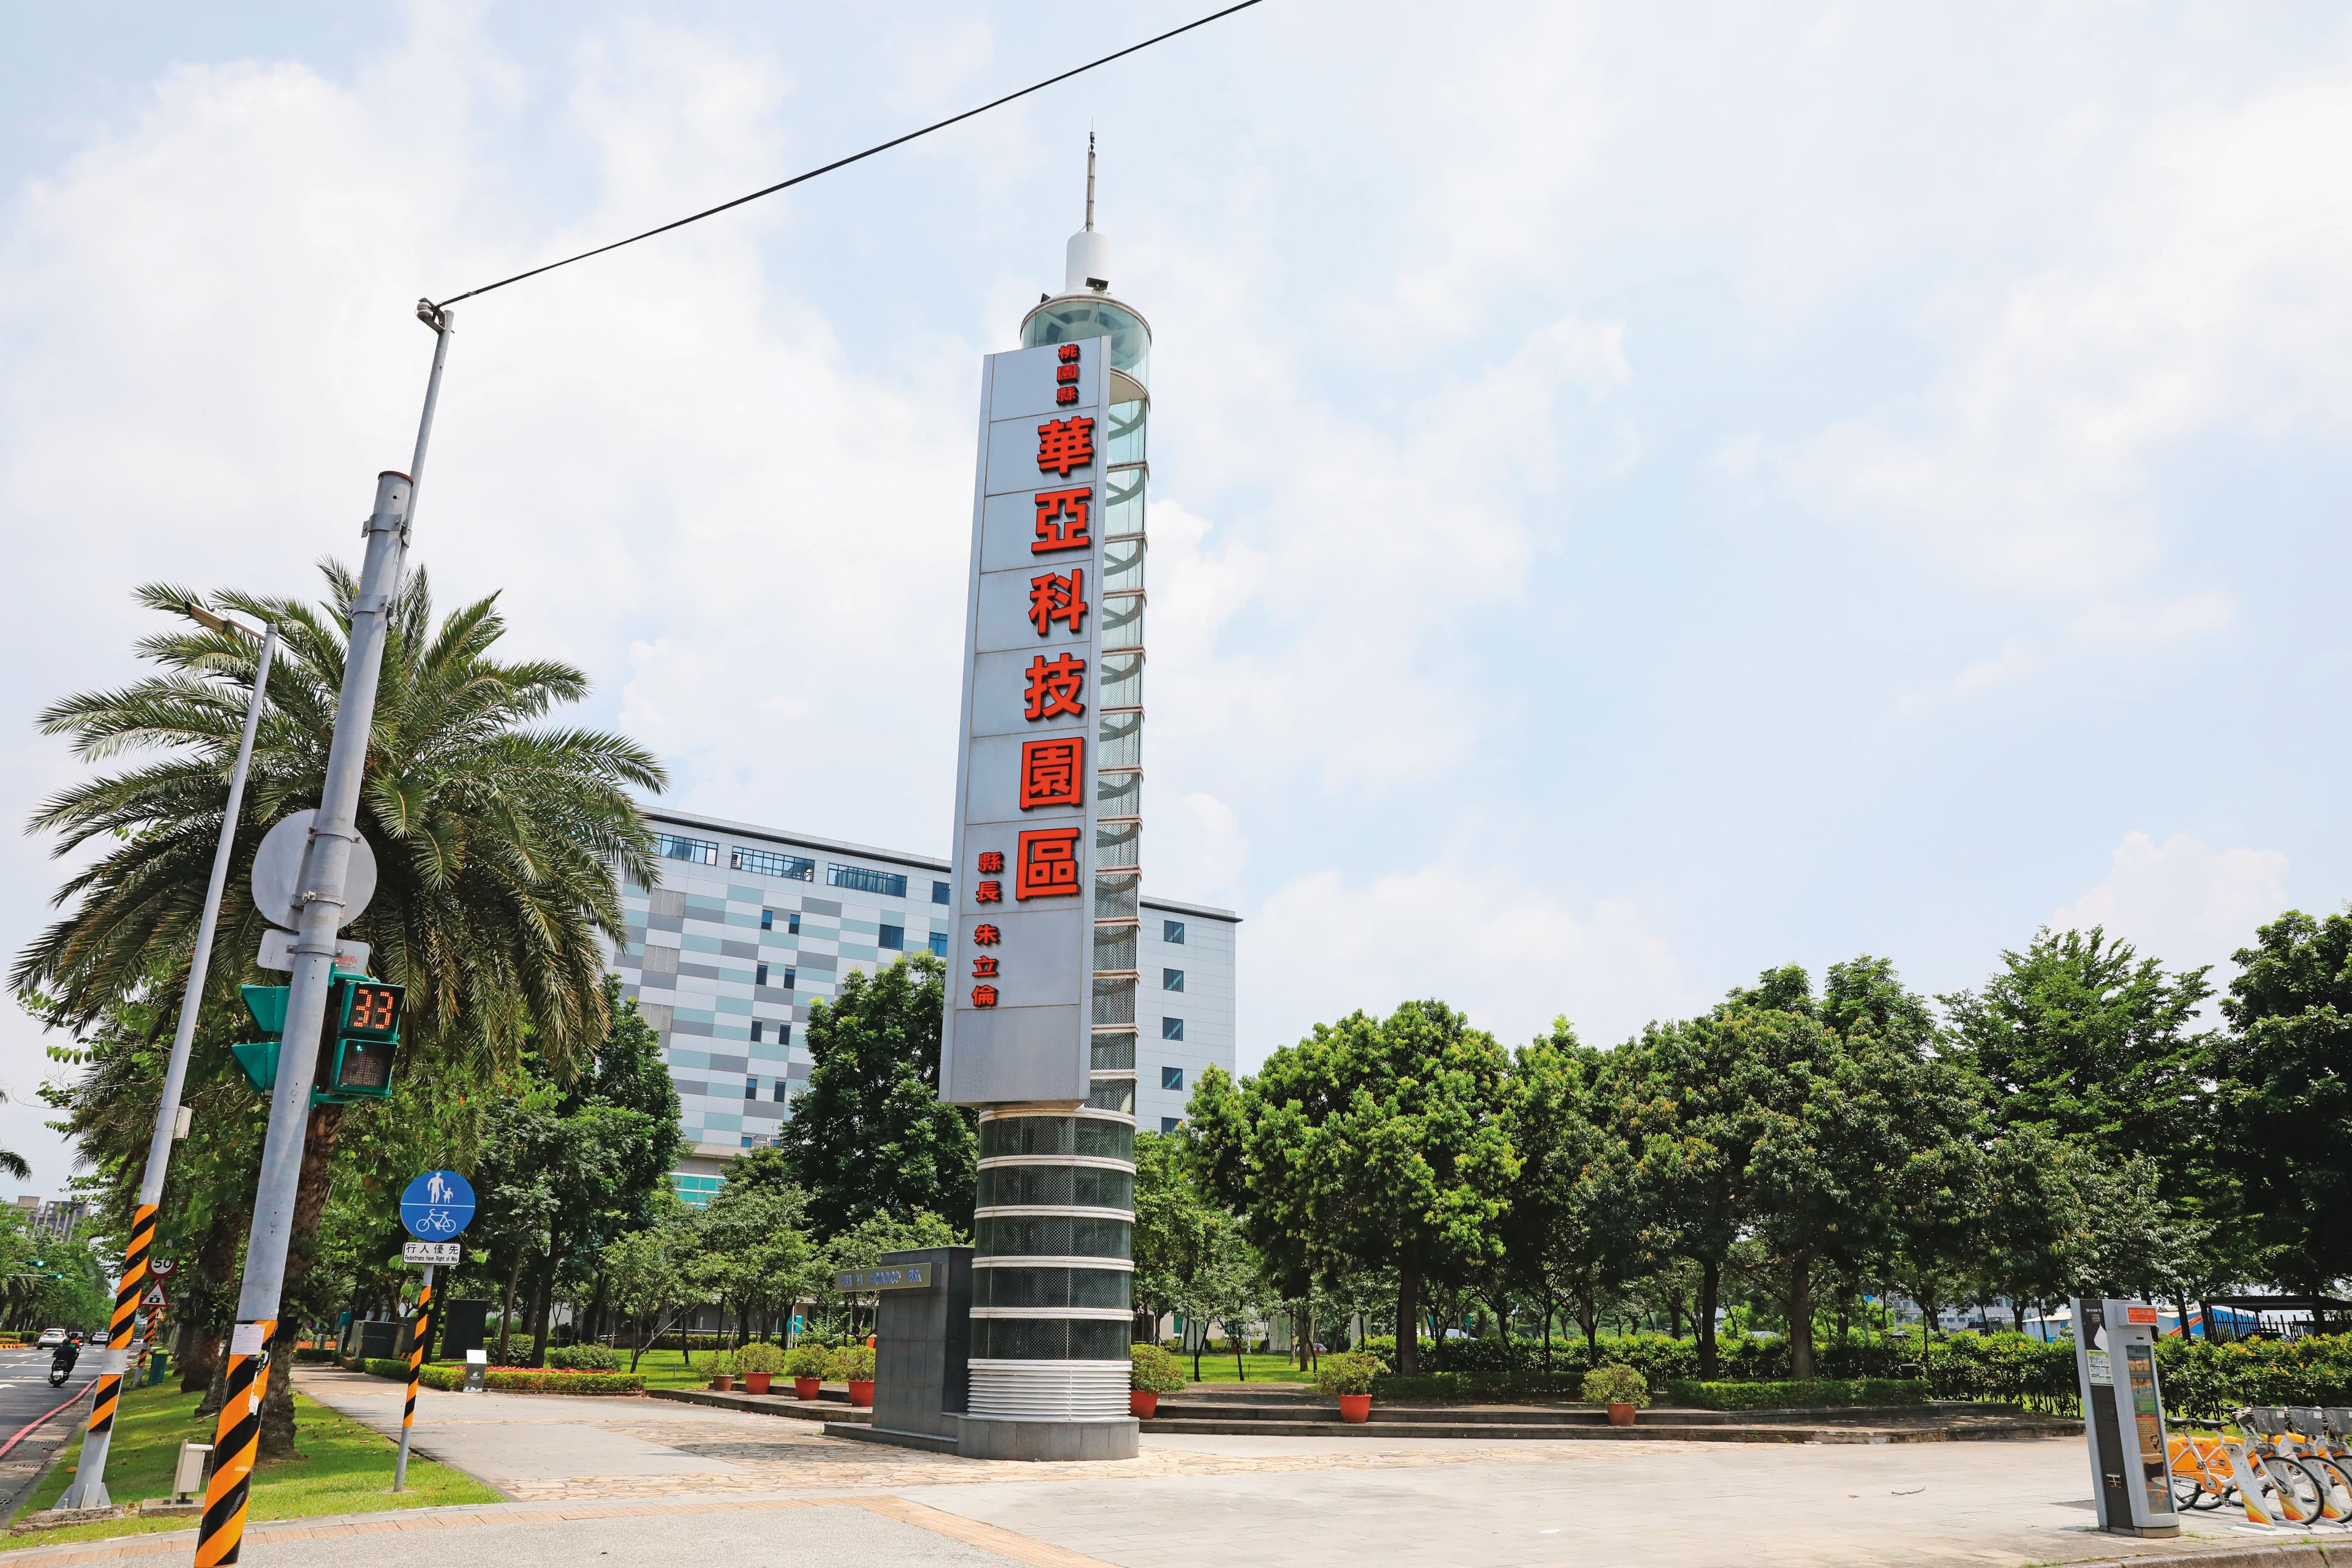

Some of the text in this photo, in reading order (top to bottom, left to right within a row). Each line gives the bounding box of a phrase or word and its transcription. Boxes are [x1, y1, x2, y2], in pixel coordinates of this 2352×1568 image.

[1057, 344, 1079, 404] 桃園縣
[1016, 416, 1095, 900] 華亞科技園區
[971, 852, 1003, 1007] 縣長 朱立倫
[353, 989, 393, 1030] 33
[154, 1257, 172, 1268] 50
[406, 1243, 459, 1255] 行人優先
